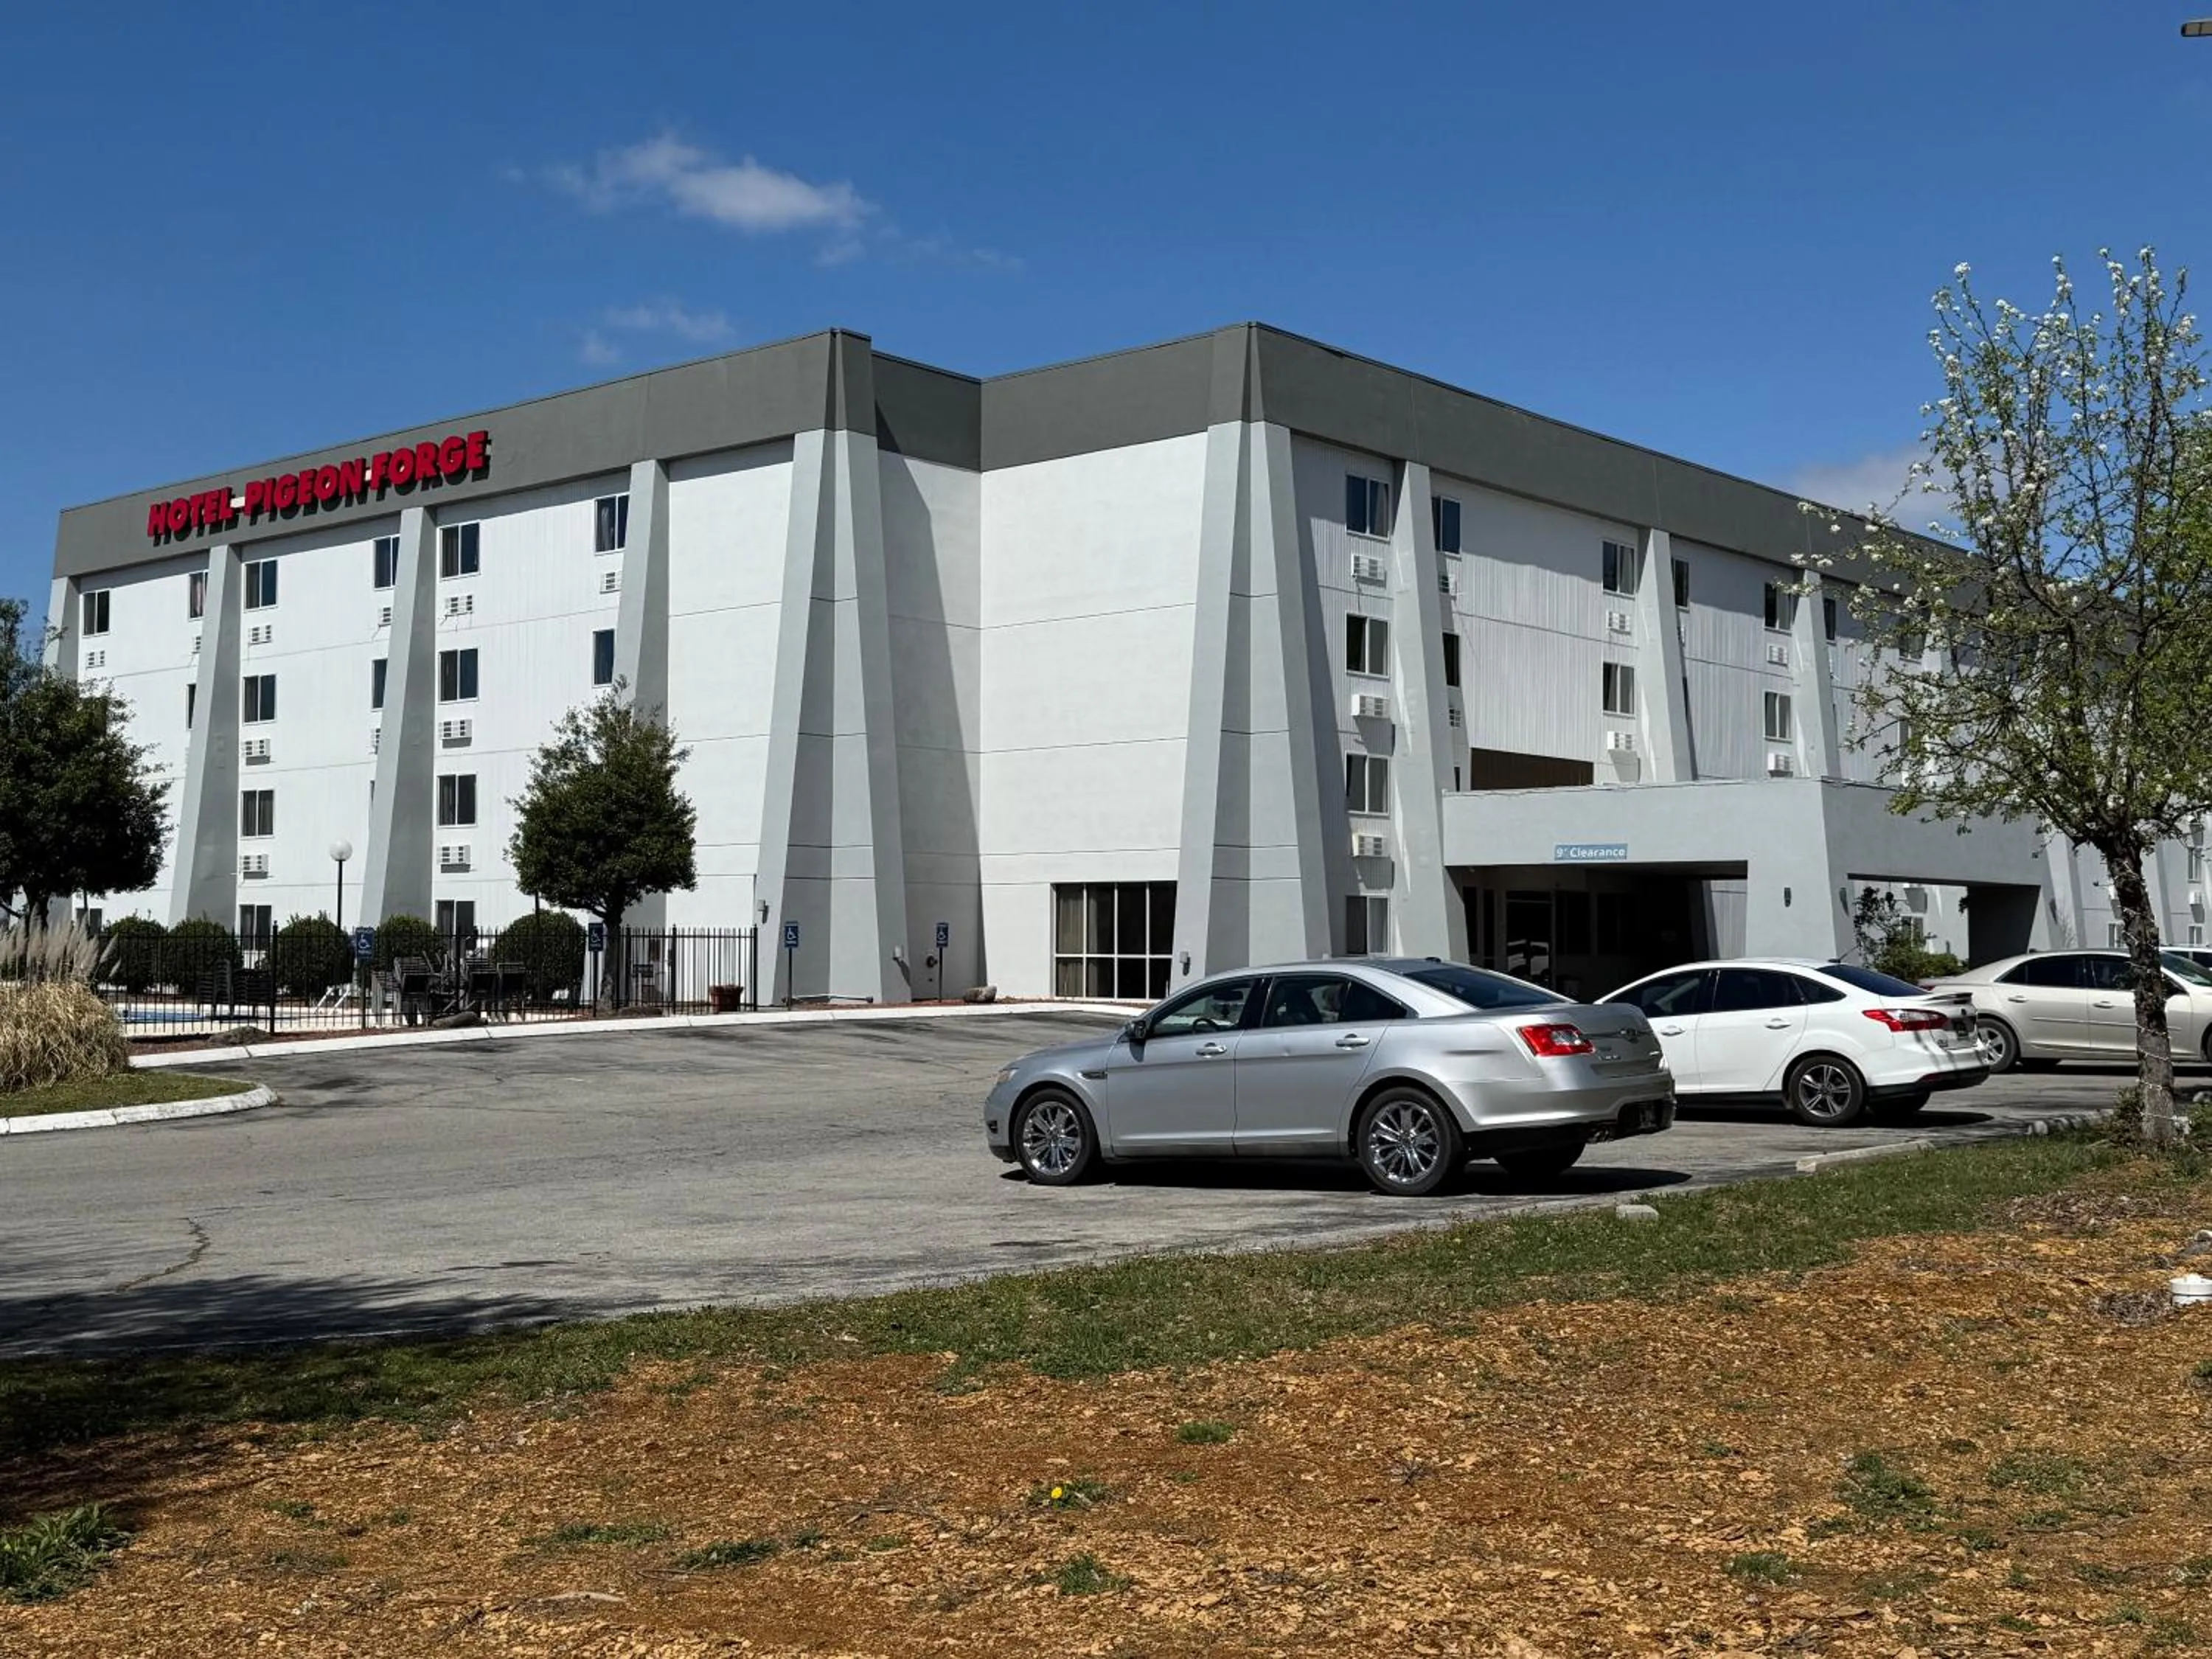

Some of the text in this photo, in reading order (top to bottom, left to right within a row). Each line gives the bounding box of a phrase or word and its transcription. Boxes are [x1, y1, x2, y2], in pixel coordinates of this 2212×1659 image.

[147, 431, 489, 536] HOTEL PIGEON FORGE
[1570, 847, 1626, 858] Clearance
